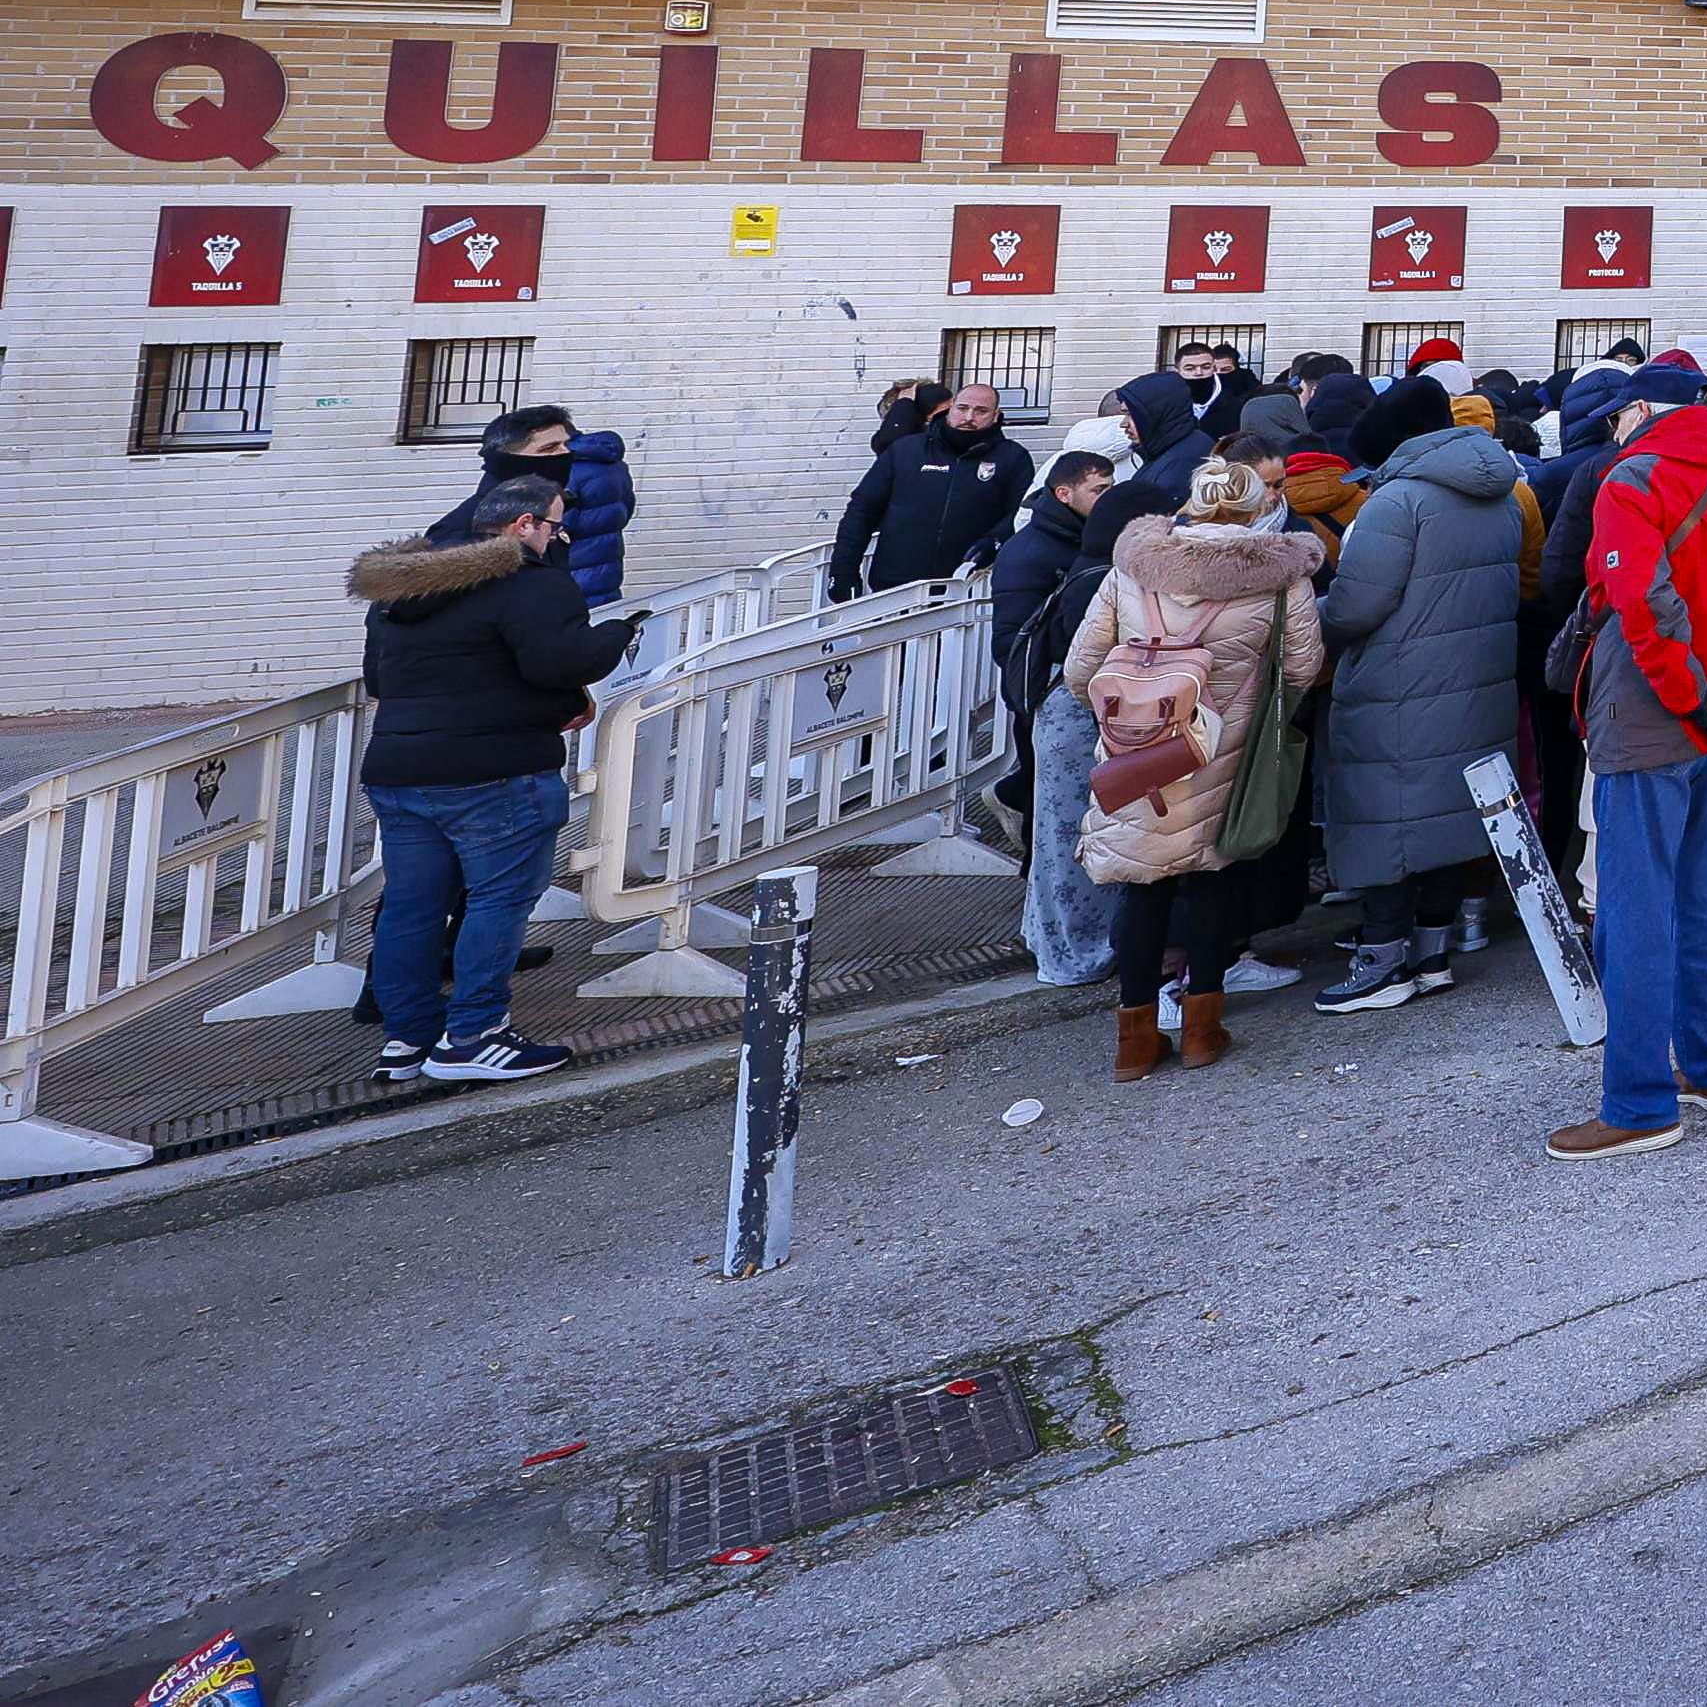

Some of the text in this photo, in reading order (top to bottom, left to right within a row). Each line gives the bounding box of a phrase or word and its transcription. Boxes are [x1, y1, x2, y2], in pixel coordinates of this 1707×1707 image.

[88, 31, 1504, 171] QUILLAS
[191, 281, 235, 291] TAQUILLA
[453, 278, 494, 288] TAQUILLA
